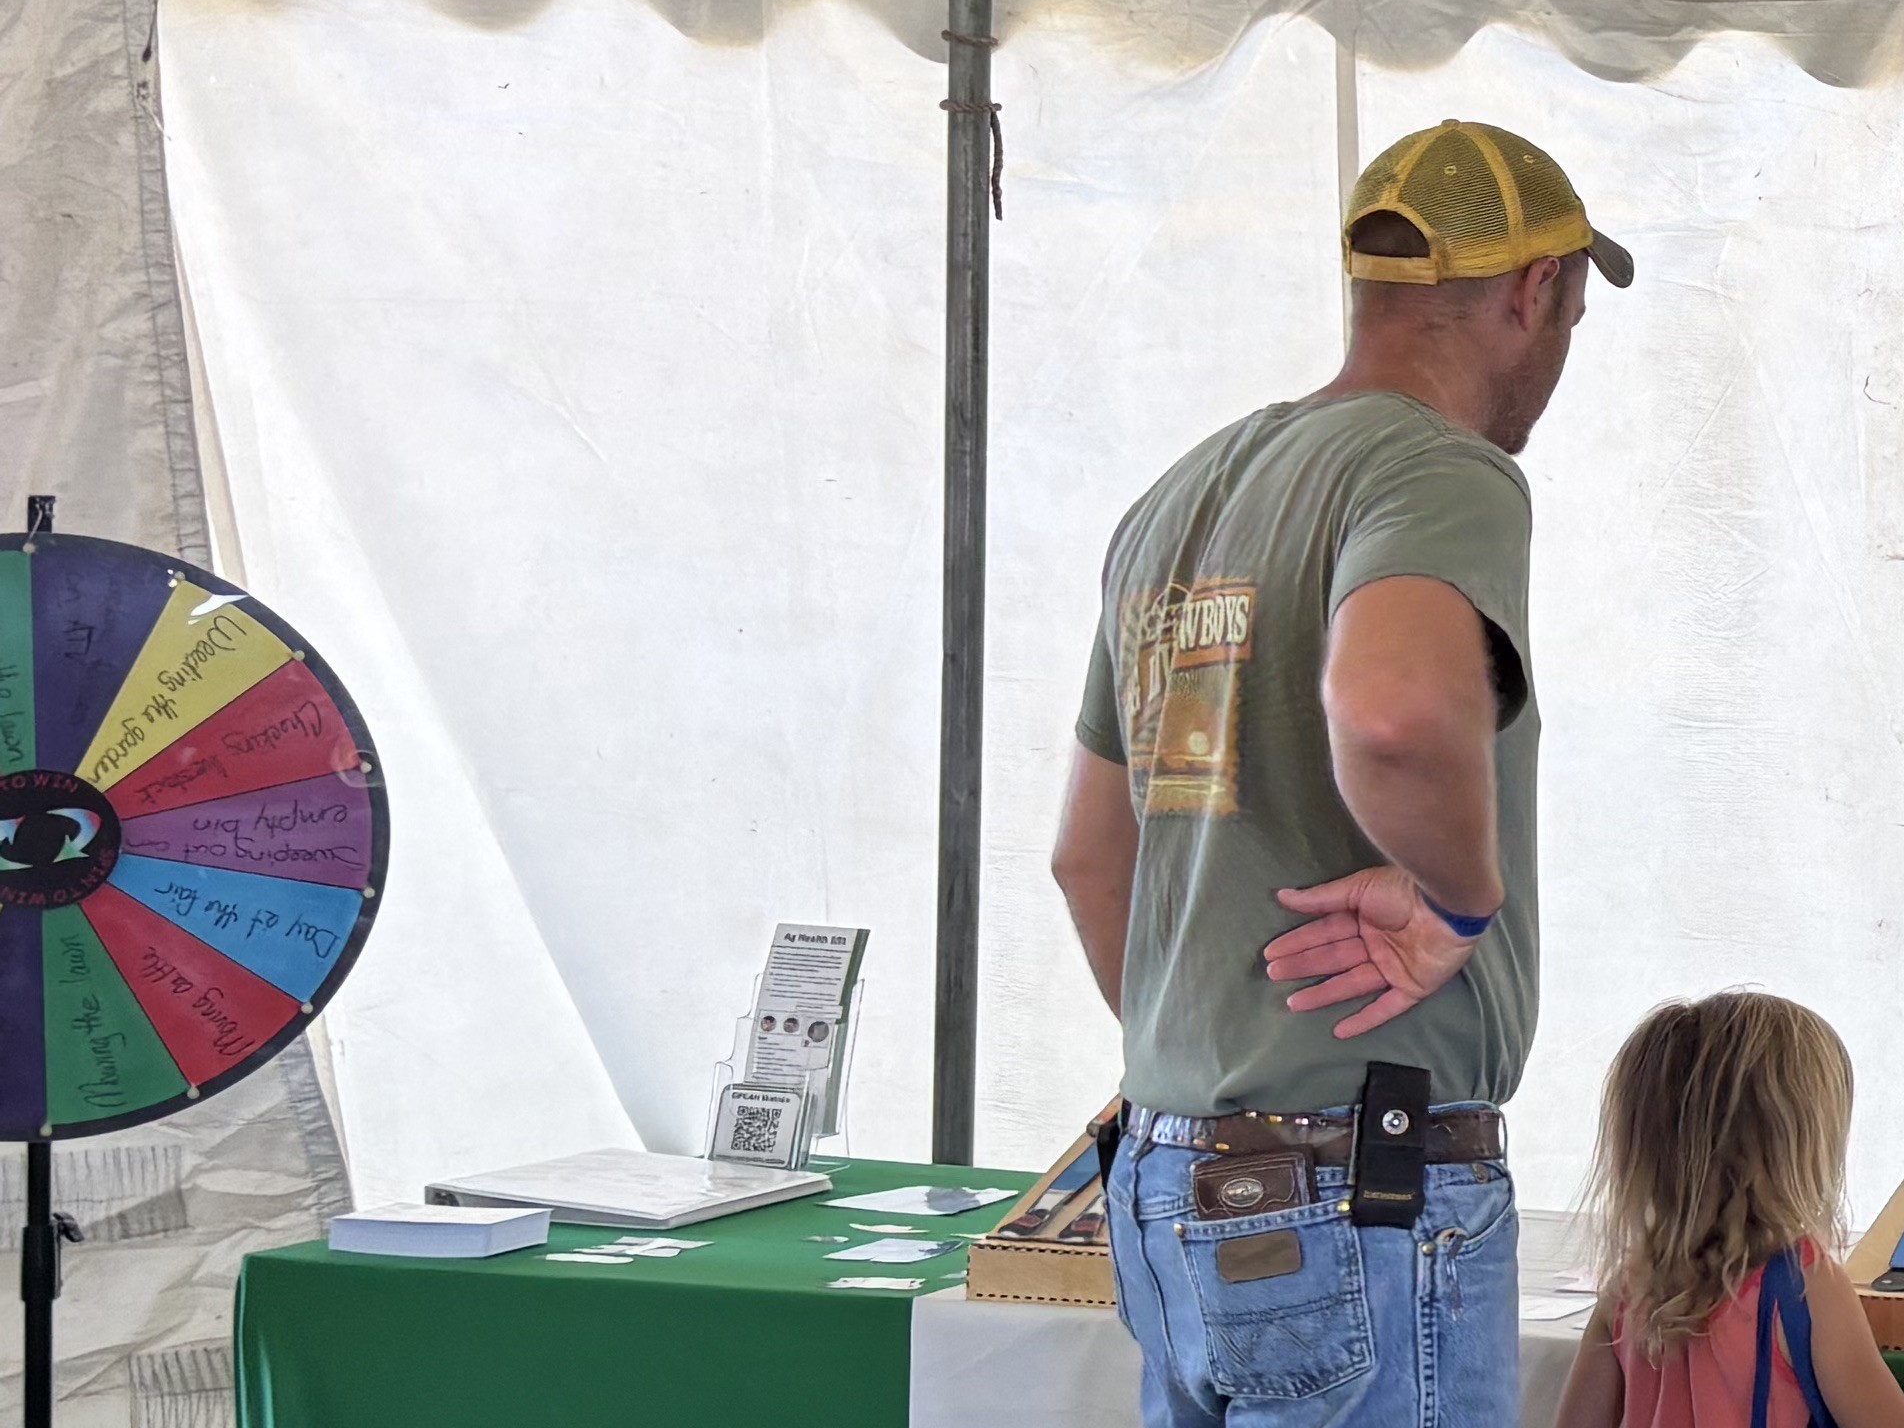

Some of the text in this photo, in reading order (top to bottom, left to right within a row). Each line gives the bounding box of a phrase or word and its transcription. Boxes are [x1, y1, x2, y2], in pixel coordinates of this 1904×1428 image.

[158, 615, 247, 692] Weeding
[87, 717, 145, 784] garden
[34, 773, 79, 793] WIN
[193, 800, 347, 845] empty bin
[184, 842, 226, 859] out
[154, 882, 199, 916] fair
[204, 900, 238, 929] the
[285, 914, 340, 959] Day
[72, 994, 100, 1034] the
